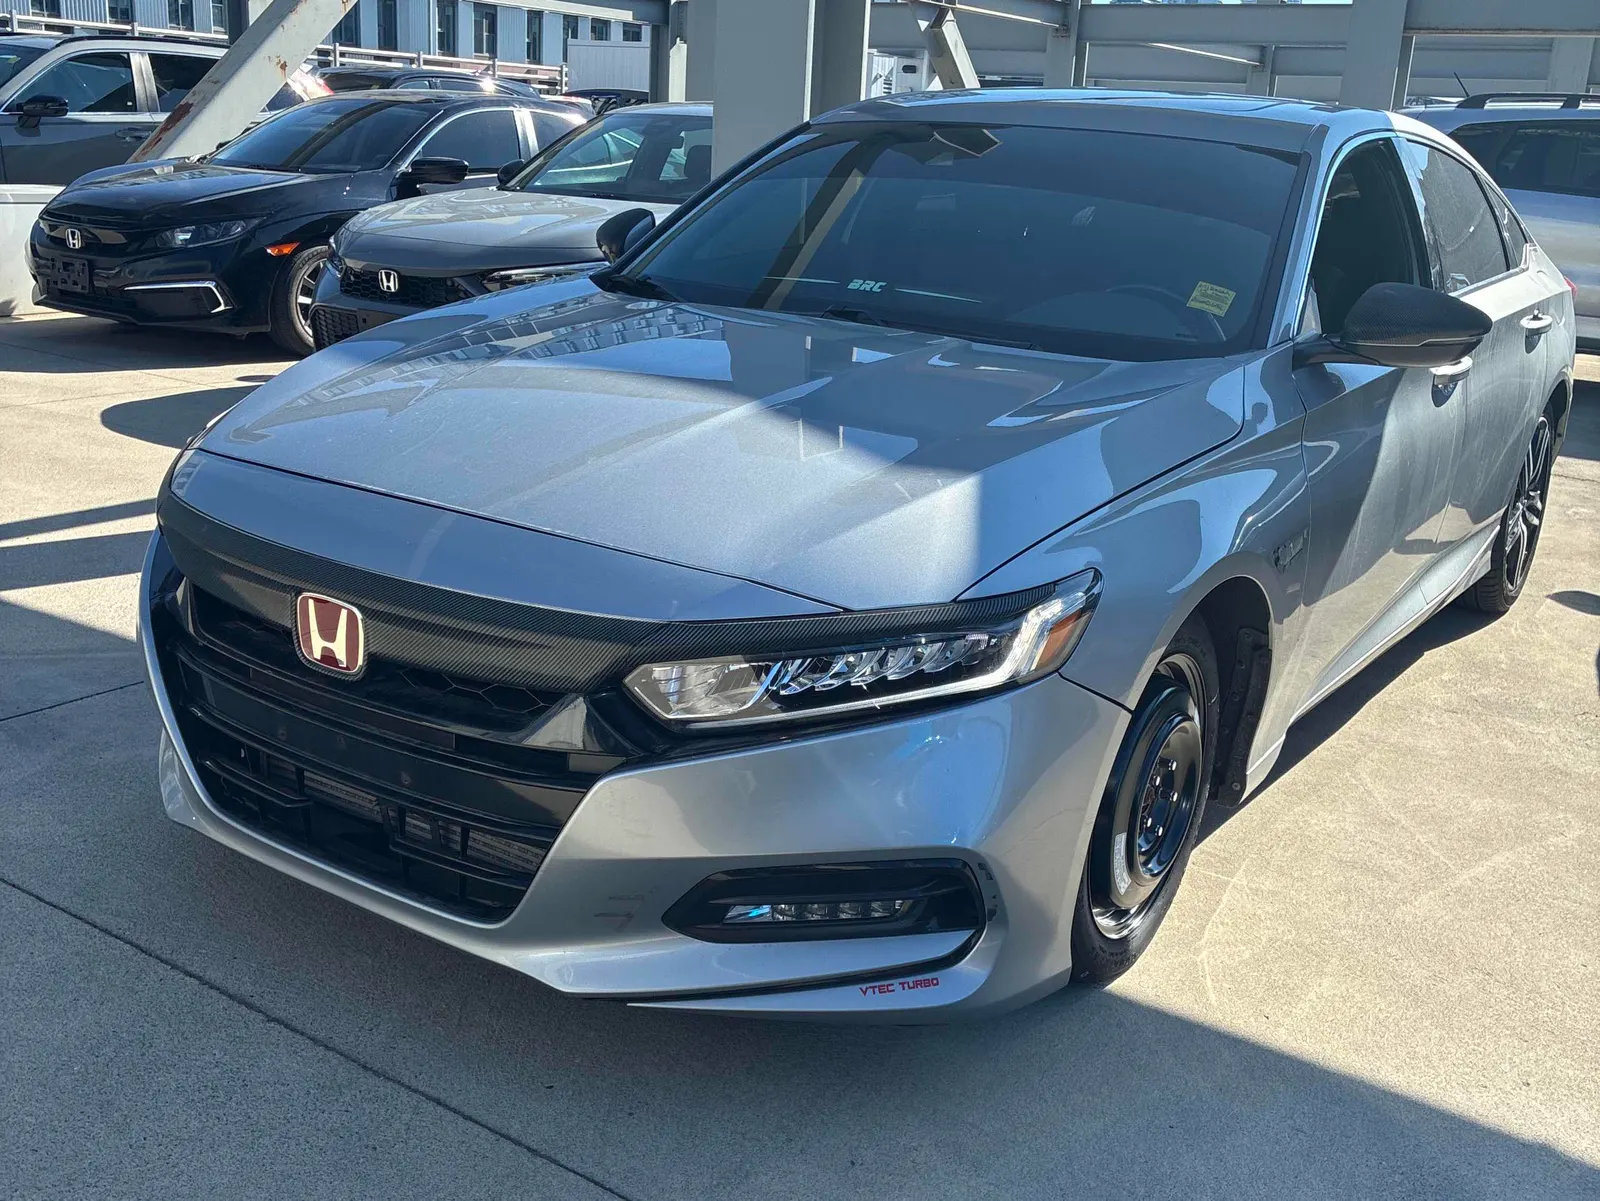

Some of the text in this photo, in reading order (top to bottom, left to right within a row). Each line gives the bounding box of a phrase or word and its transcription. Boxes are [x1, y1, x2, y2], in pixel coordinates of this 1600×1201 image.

[381, 270, 396, 292] H
[847, 279, 887, 292] BRC
[308, 598, 347, 667] H
[859, 977, 940, 996] VTEC TURBO
